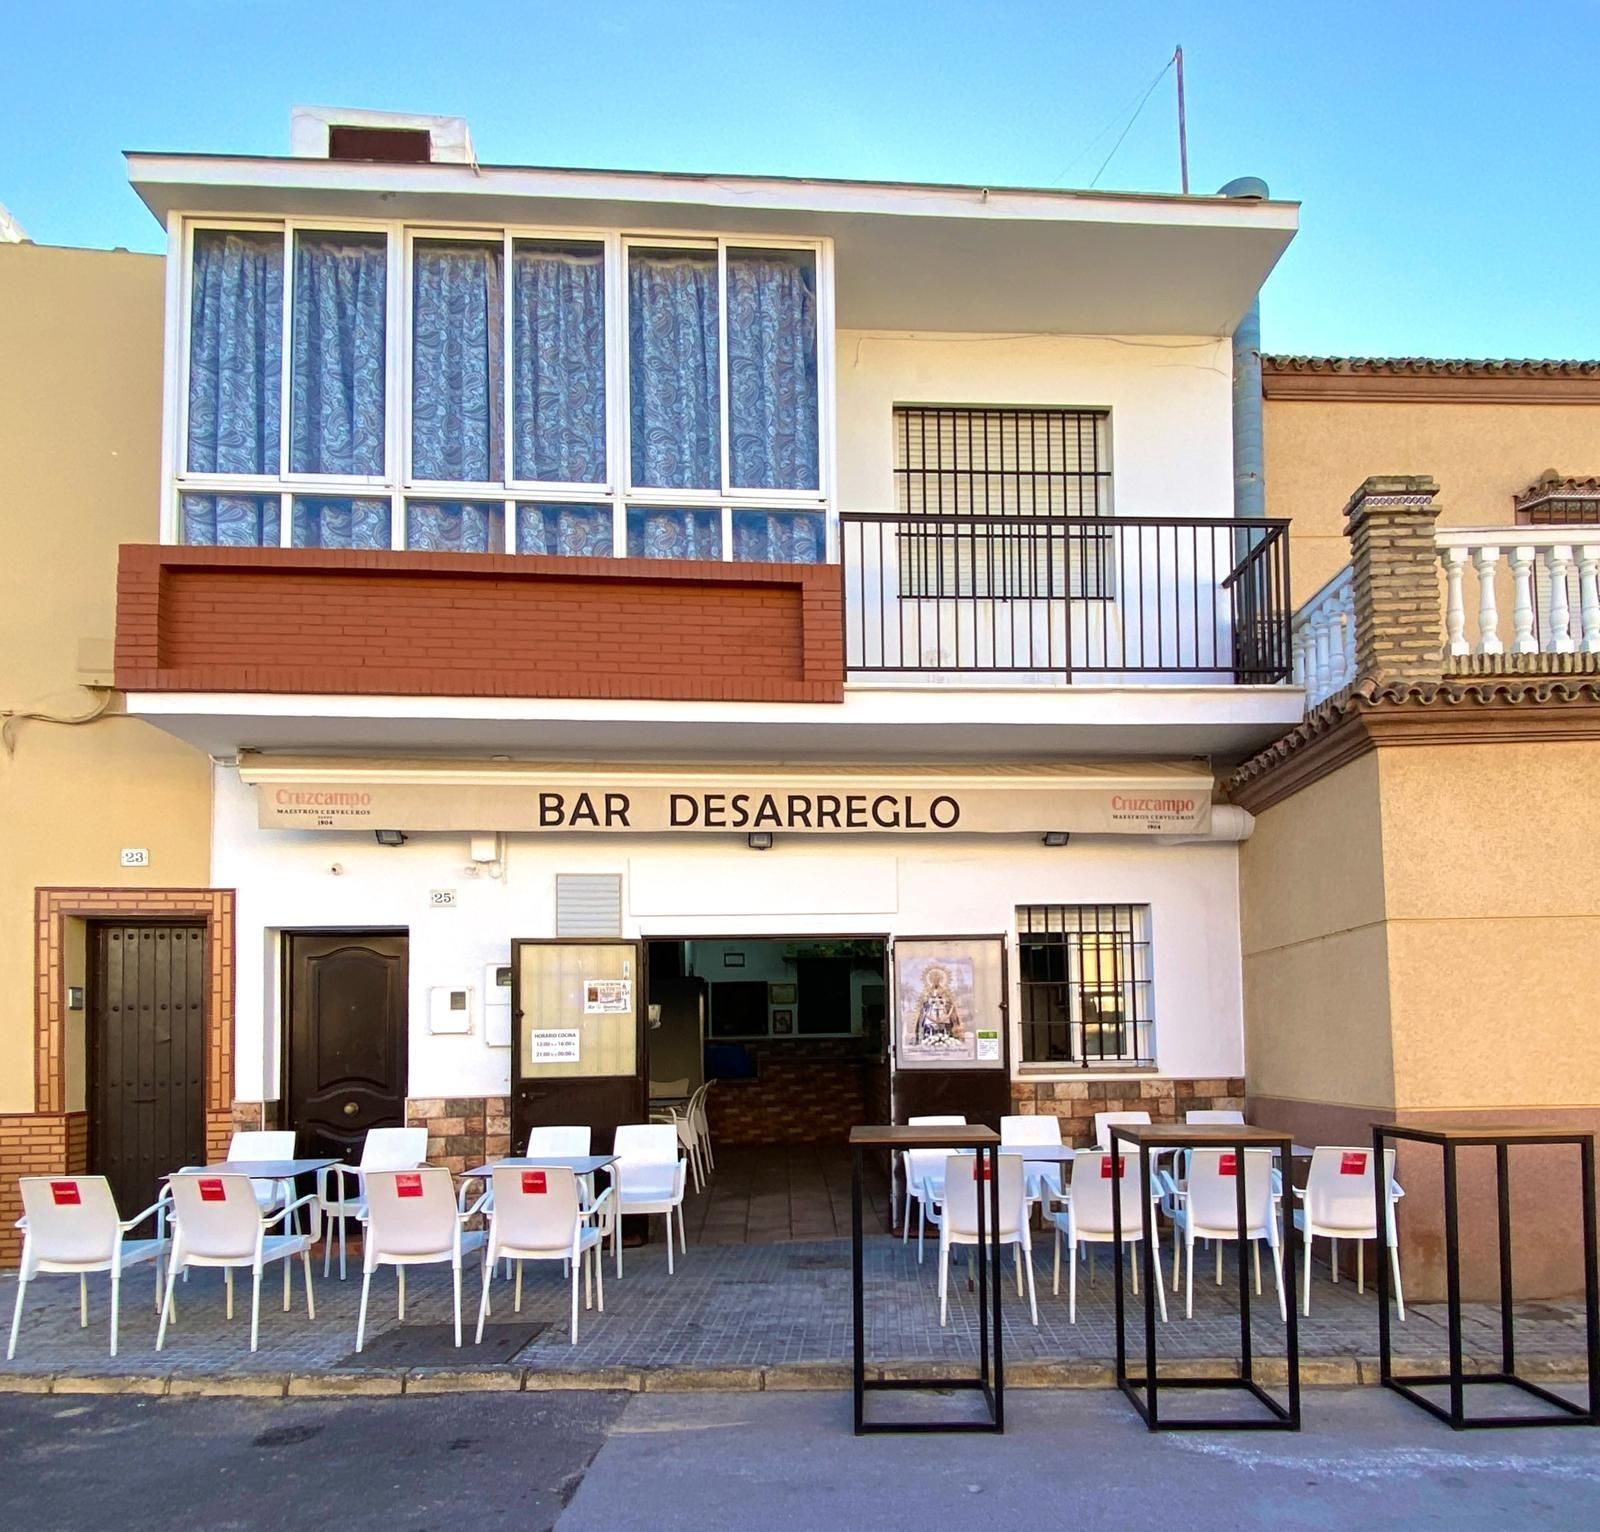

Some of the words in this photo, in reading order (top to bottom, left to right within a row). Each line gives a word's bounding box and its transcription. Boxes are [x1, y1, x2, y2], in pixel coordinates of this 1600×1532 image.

[276, 789, 371, 808] Cruzcampo
[1111, 795, 1195, 814] Cruzcampo
[538, 793, 630, 827] BAR
[669, 794, 961, 829] DESARREGLO
[125, 851, 144, 863] 23
[433, 892, 452, 904] 25
